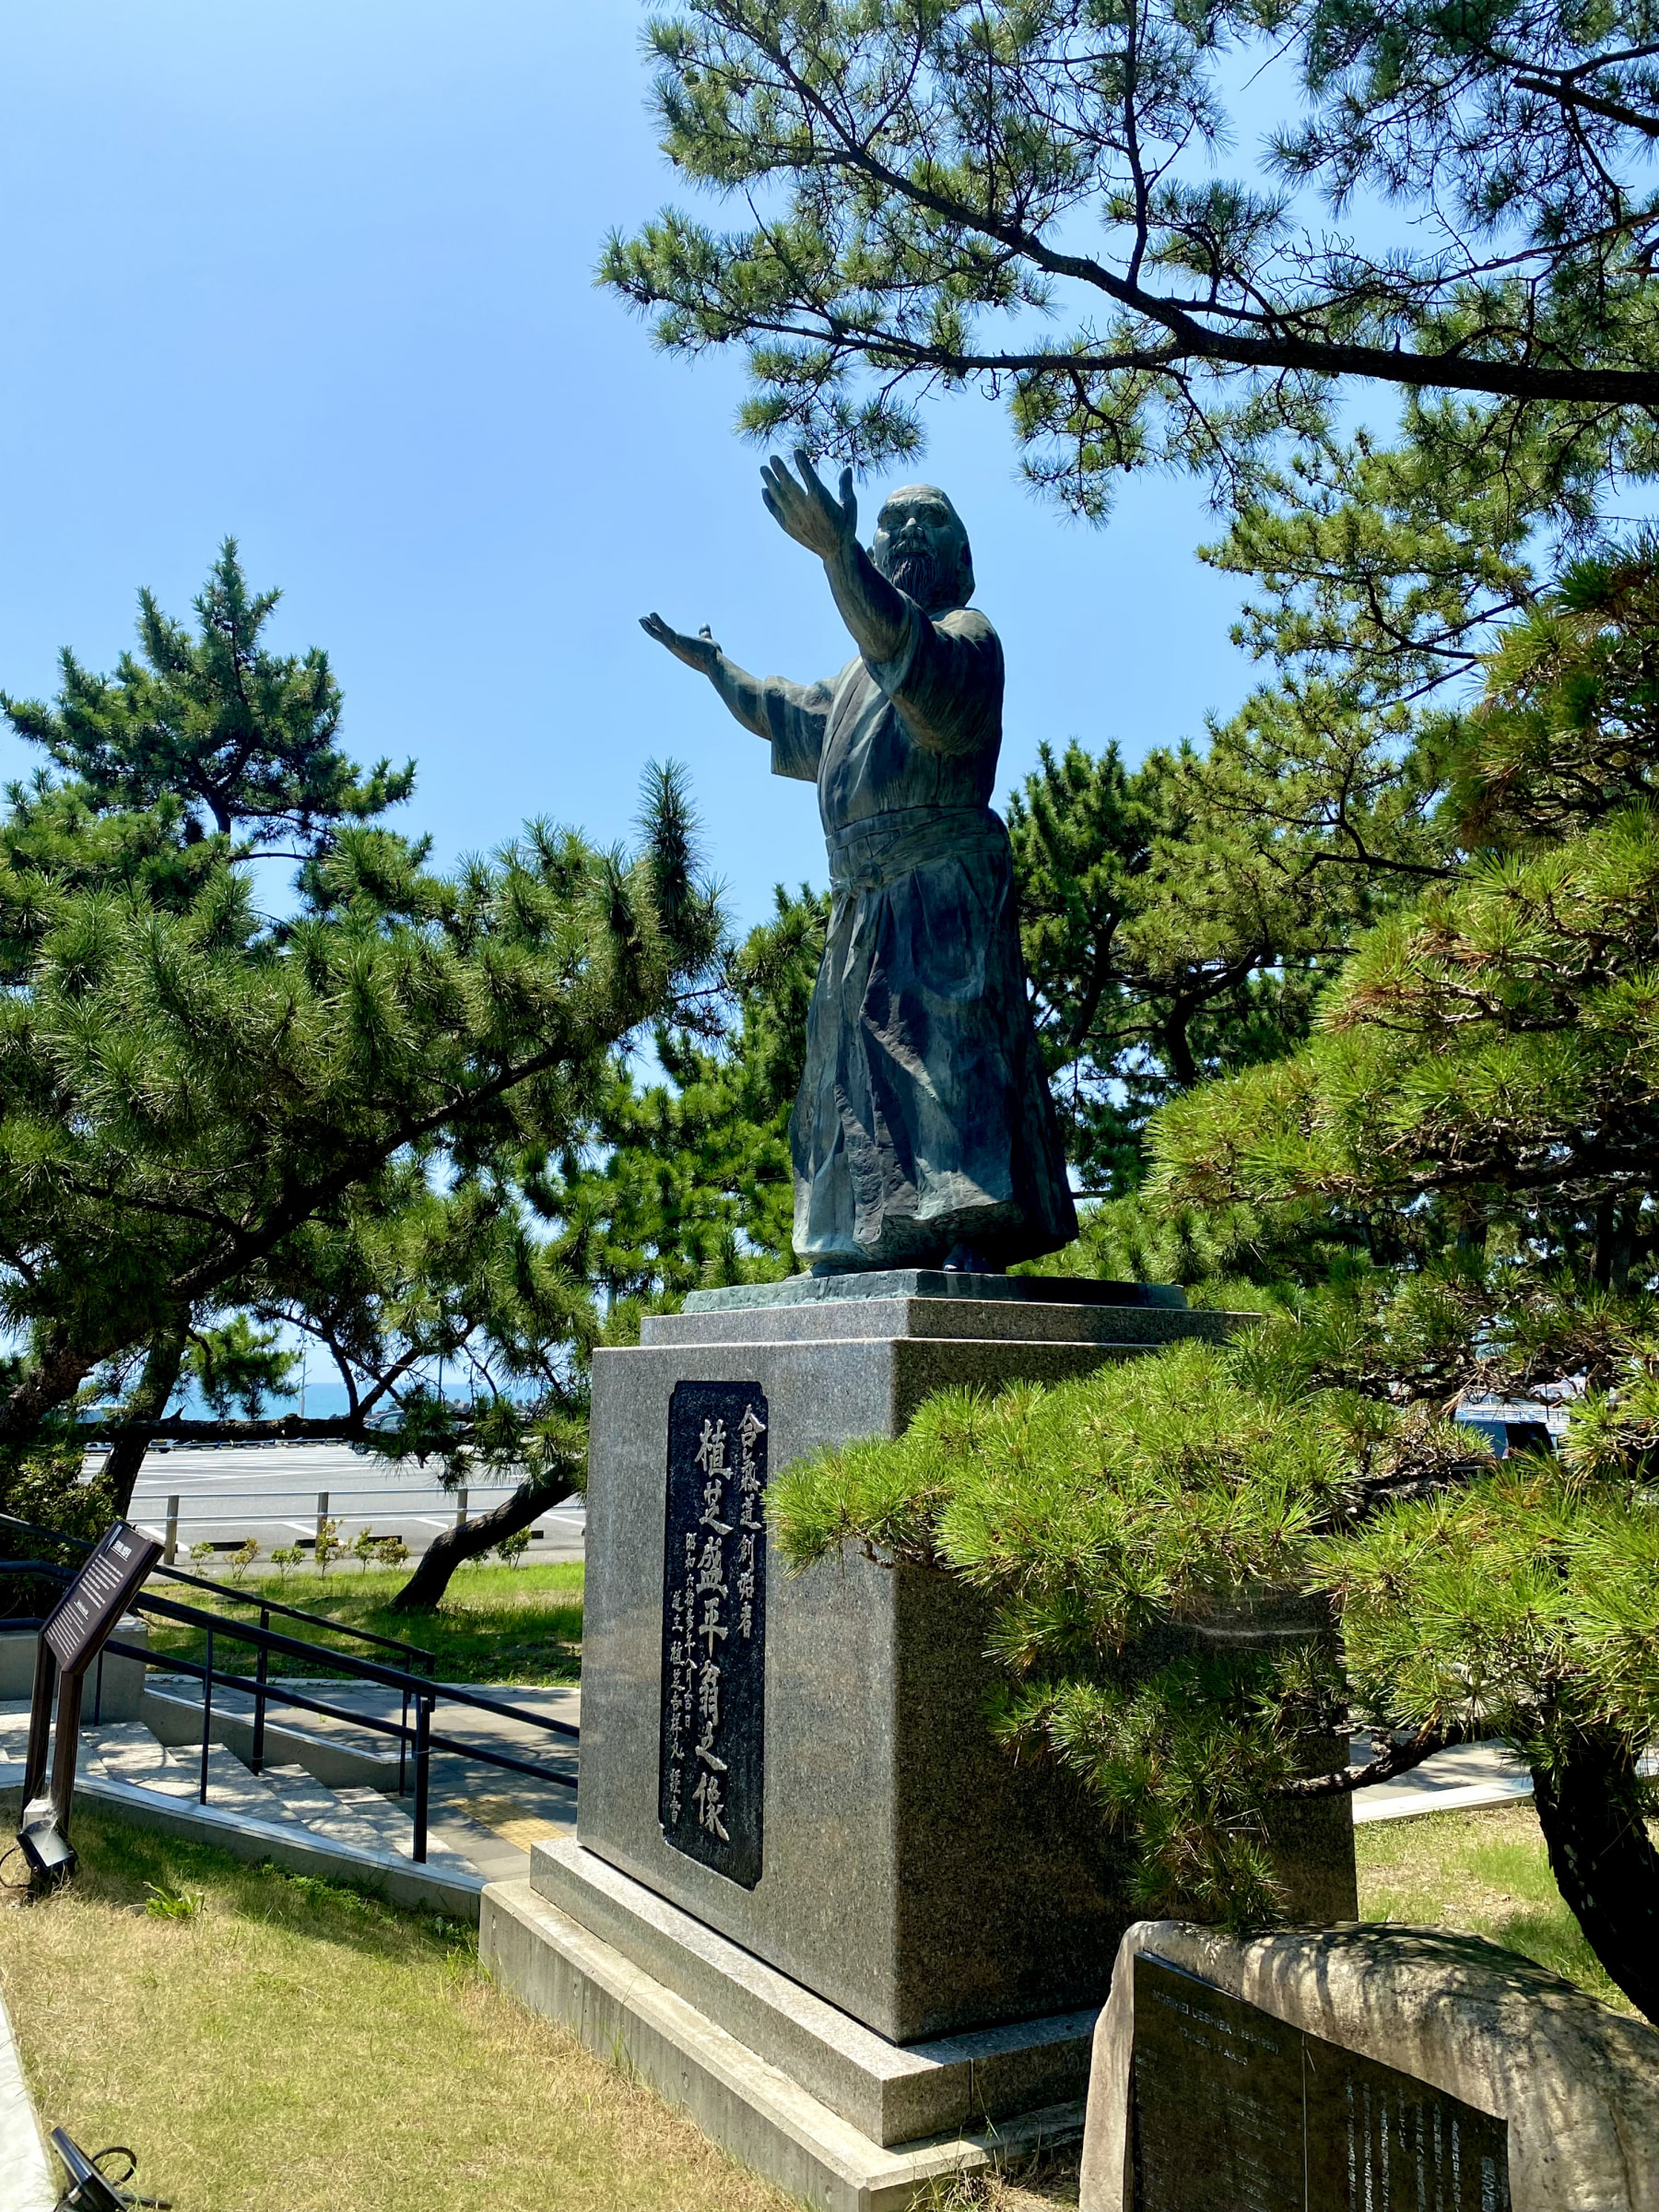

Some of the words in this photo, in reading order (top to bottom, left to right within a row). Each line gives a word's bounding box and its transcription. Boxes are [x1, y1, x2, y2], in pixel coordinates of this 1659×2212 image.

[692, 1418, 734, 1841] 植芝盛平翁之像
